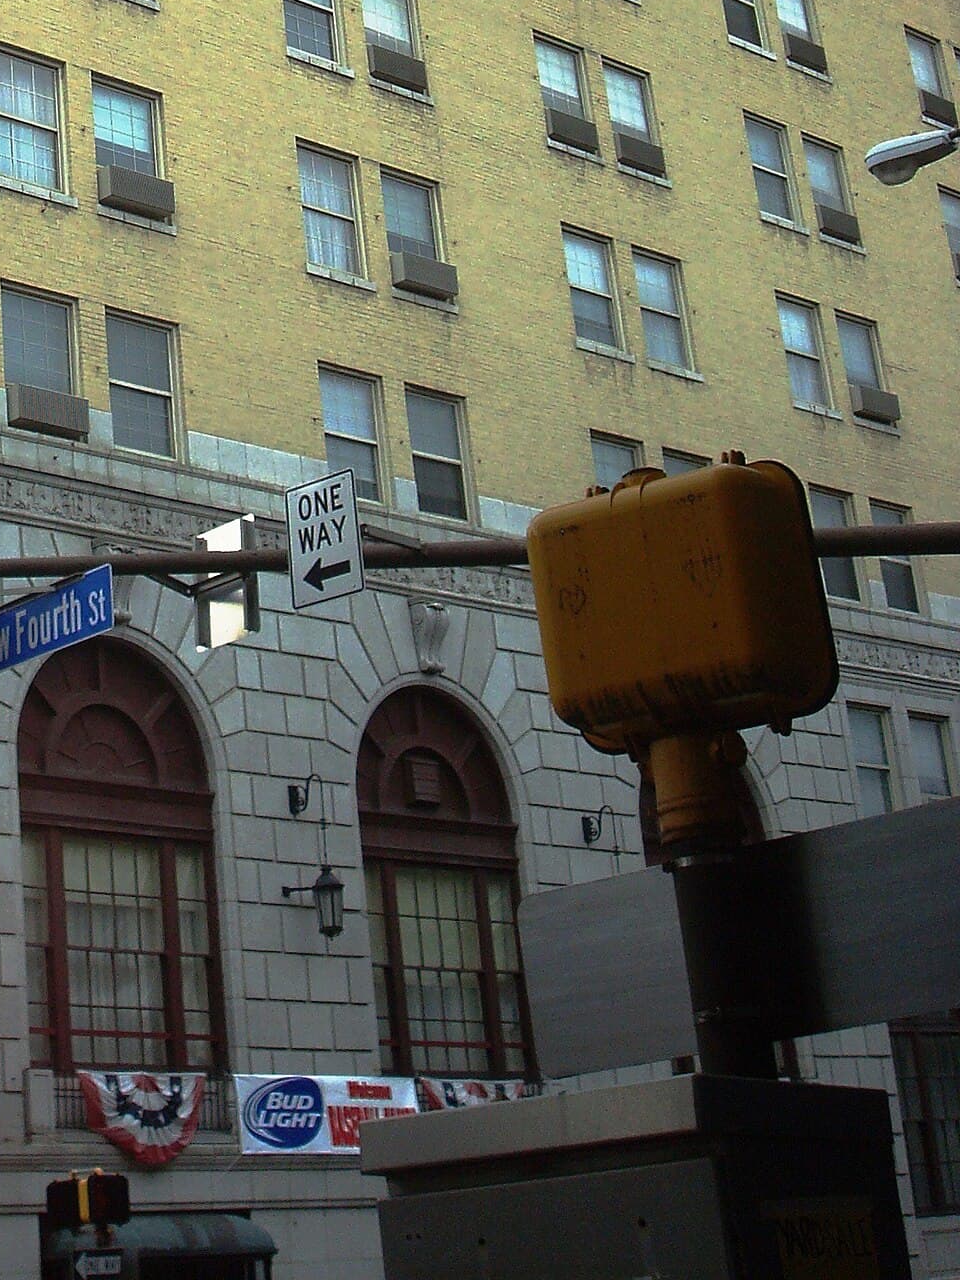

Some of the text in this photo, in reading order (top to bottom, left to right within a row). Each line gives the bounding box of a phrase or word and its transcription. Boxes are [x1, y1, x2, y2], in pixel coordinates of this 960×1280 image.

[298, 483, 344, 521] ONE
[298, 515, 346, 554] WAY
[15, 588, 81, 655] Fourth
[88, 588, 106, 626] St
[257, 1110, 321, 1128] LIGHT
[268, 1092, 314, 1110] BUD
